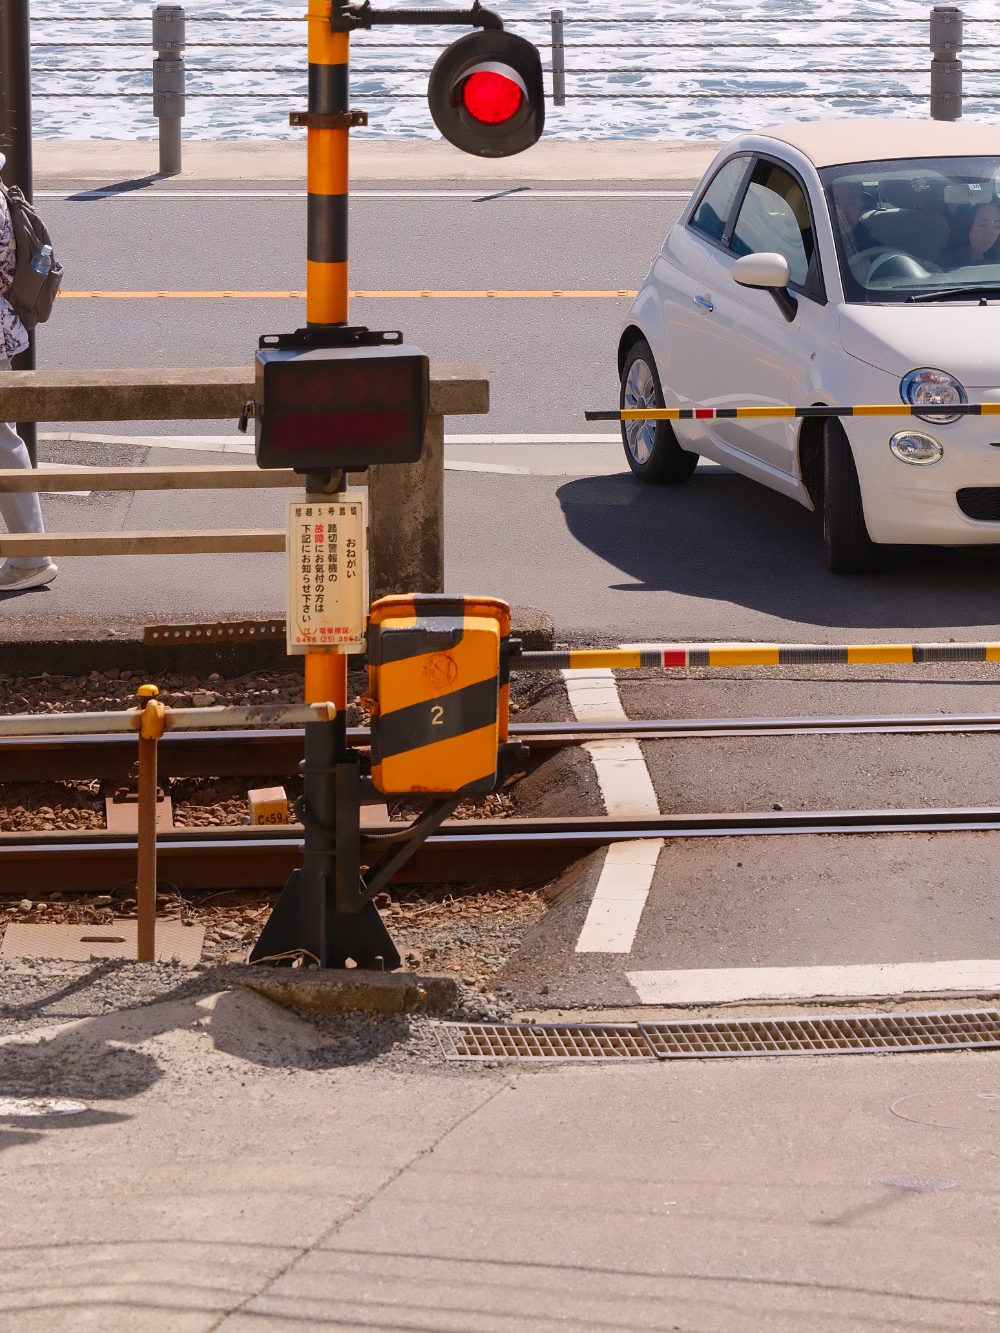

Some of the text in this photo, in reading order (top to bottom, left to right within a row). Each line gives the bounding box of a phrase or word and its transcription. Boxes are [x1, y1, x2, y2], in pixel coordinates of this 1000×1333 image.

[301, 524, 312, 623] 下記にお知らせ下さい
[314, 524, 325, 613] 故障にお気付の方は
[327, 524, 338, 582] 踏切警報機の
[346, 538, 357, 578] おねがい
[430, 705, 444, 725] 2
